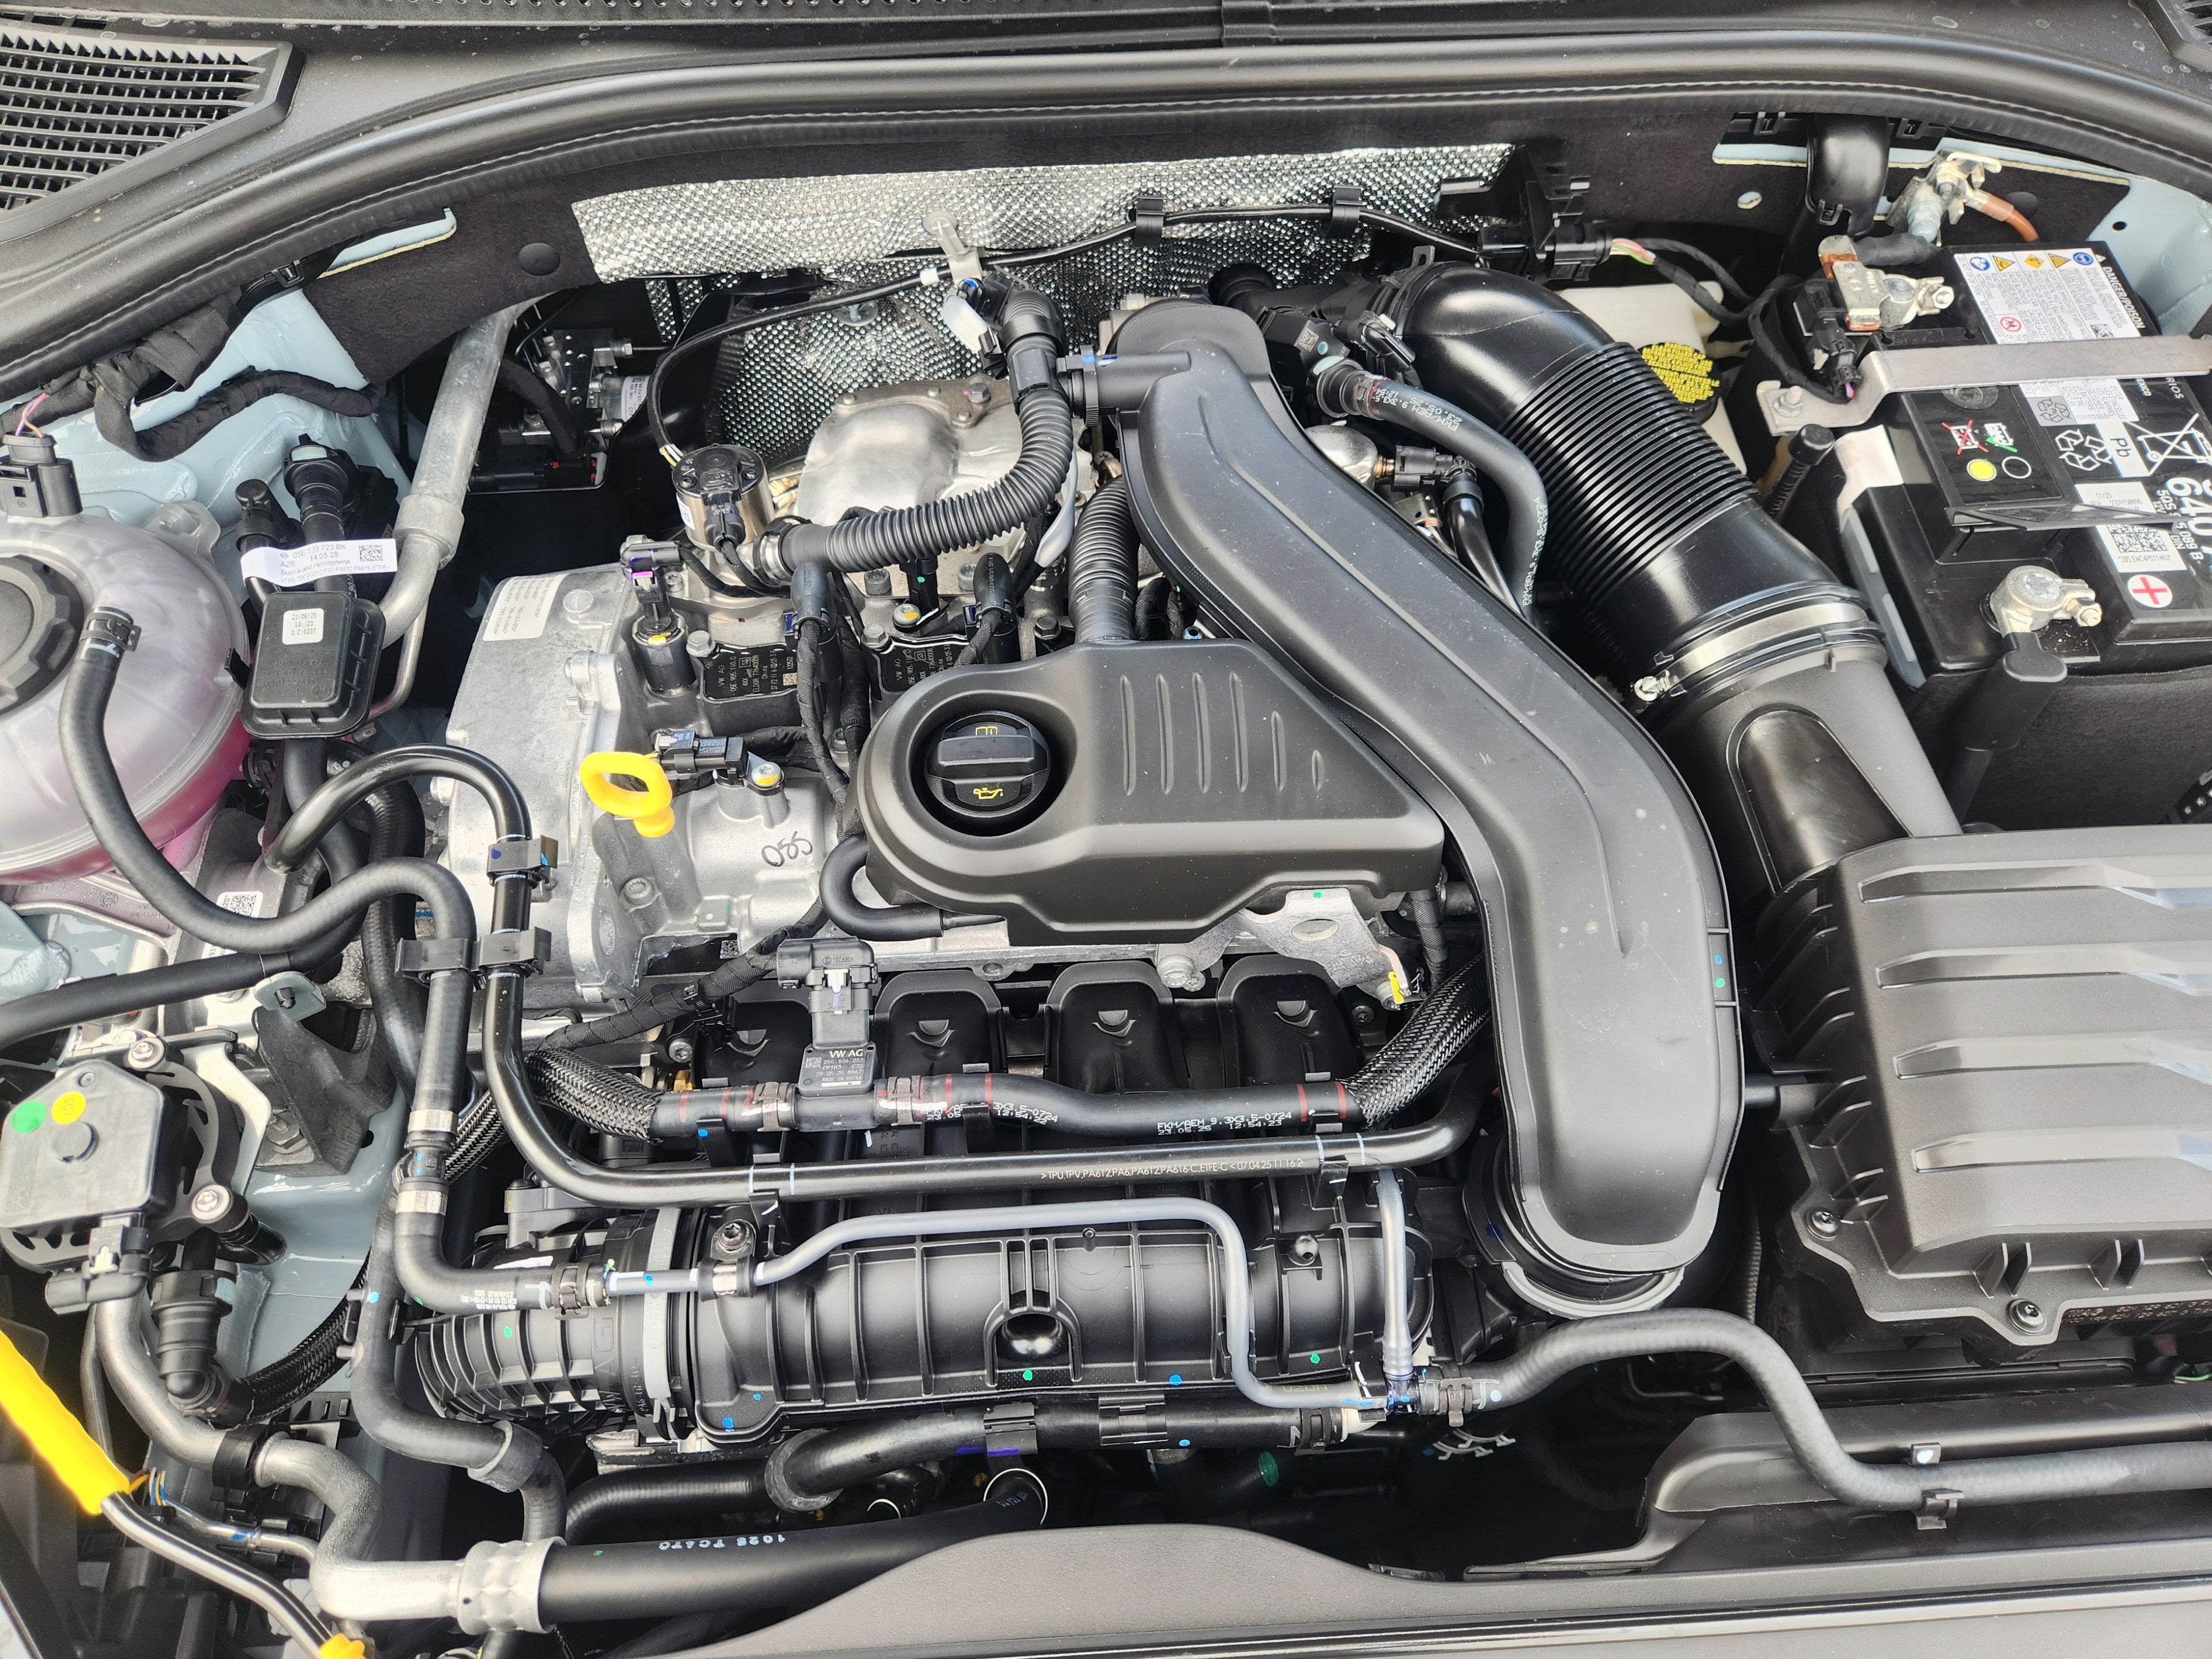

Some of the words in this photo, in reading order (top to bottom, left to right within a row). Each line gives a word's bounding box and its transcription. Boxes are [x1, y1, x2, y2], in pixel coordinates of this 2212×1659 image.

[2102, 267, 2146, 328] DANGER/POISON
[2137, 378, 2152, 397] EXICO
[2165, 377, 2184, 399] RIOS
[1408, 397, 1463, 425] 23.05.25
[1411, 404, 1459, 431] FKM/AEM
[2109, 437, 2132, 458] Pb
[2152, 500, 2166, 513] 12V
[2170, 535, 2185, 549] DIN
[2156, 490, 2177, 509] 5QS
[2179, 531, 2198, 549] 089
[307, 546, 319, 554] 133
[281, 567, 301, 576] Bosna
[302, 564, 312, 572] and
[718, 664, 725, 673] AG
[894, 658, 901, 667] AG
[717, 677, 725, 686] VW
[895, 671, 903, 680] VW
[829, 1050, 846, 1058] VW
[848, 1048, 863, 1057] AG
[992, 1101, 1058, 1123] 3X3.5-0724
[1157, 1118, 1205, 1130] FKM/AEM
[1210, 1111, 1292, 1126] 9.3X3.5-0724
[1157, 1125, 1212, 1135] 23.05.25
[1229, 1119, 1282, 1130] 12:54:23
[1237, 1160, 1271, 1170] 07.04.25
